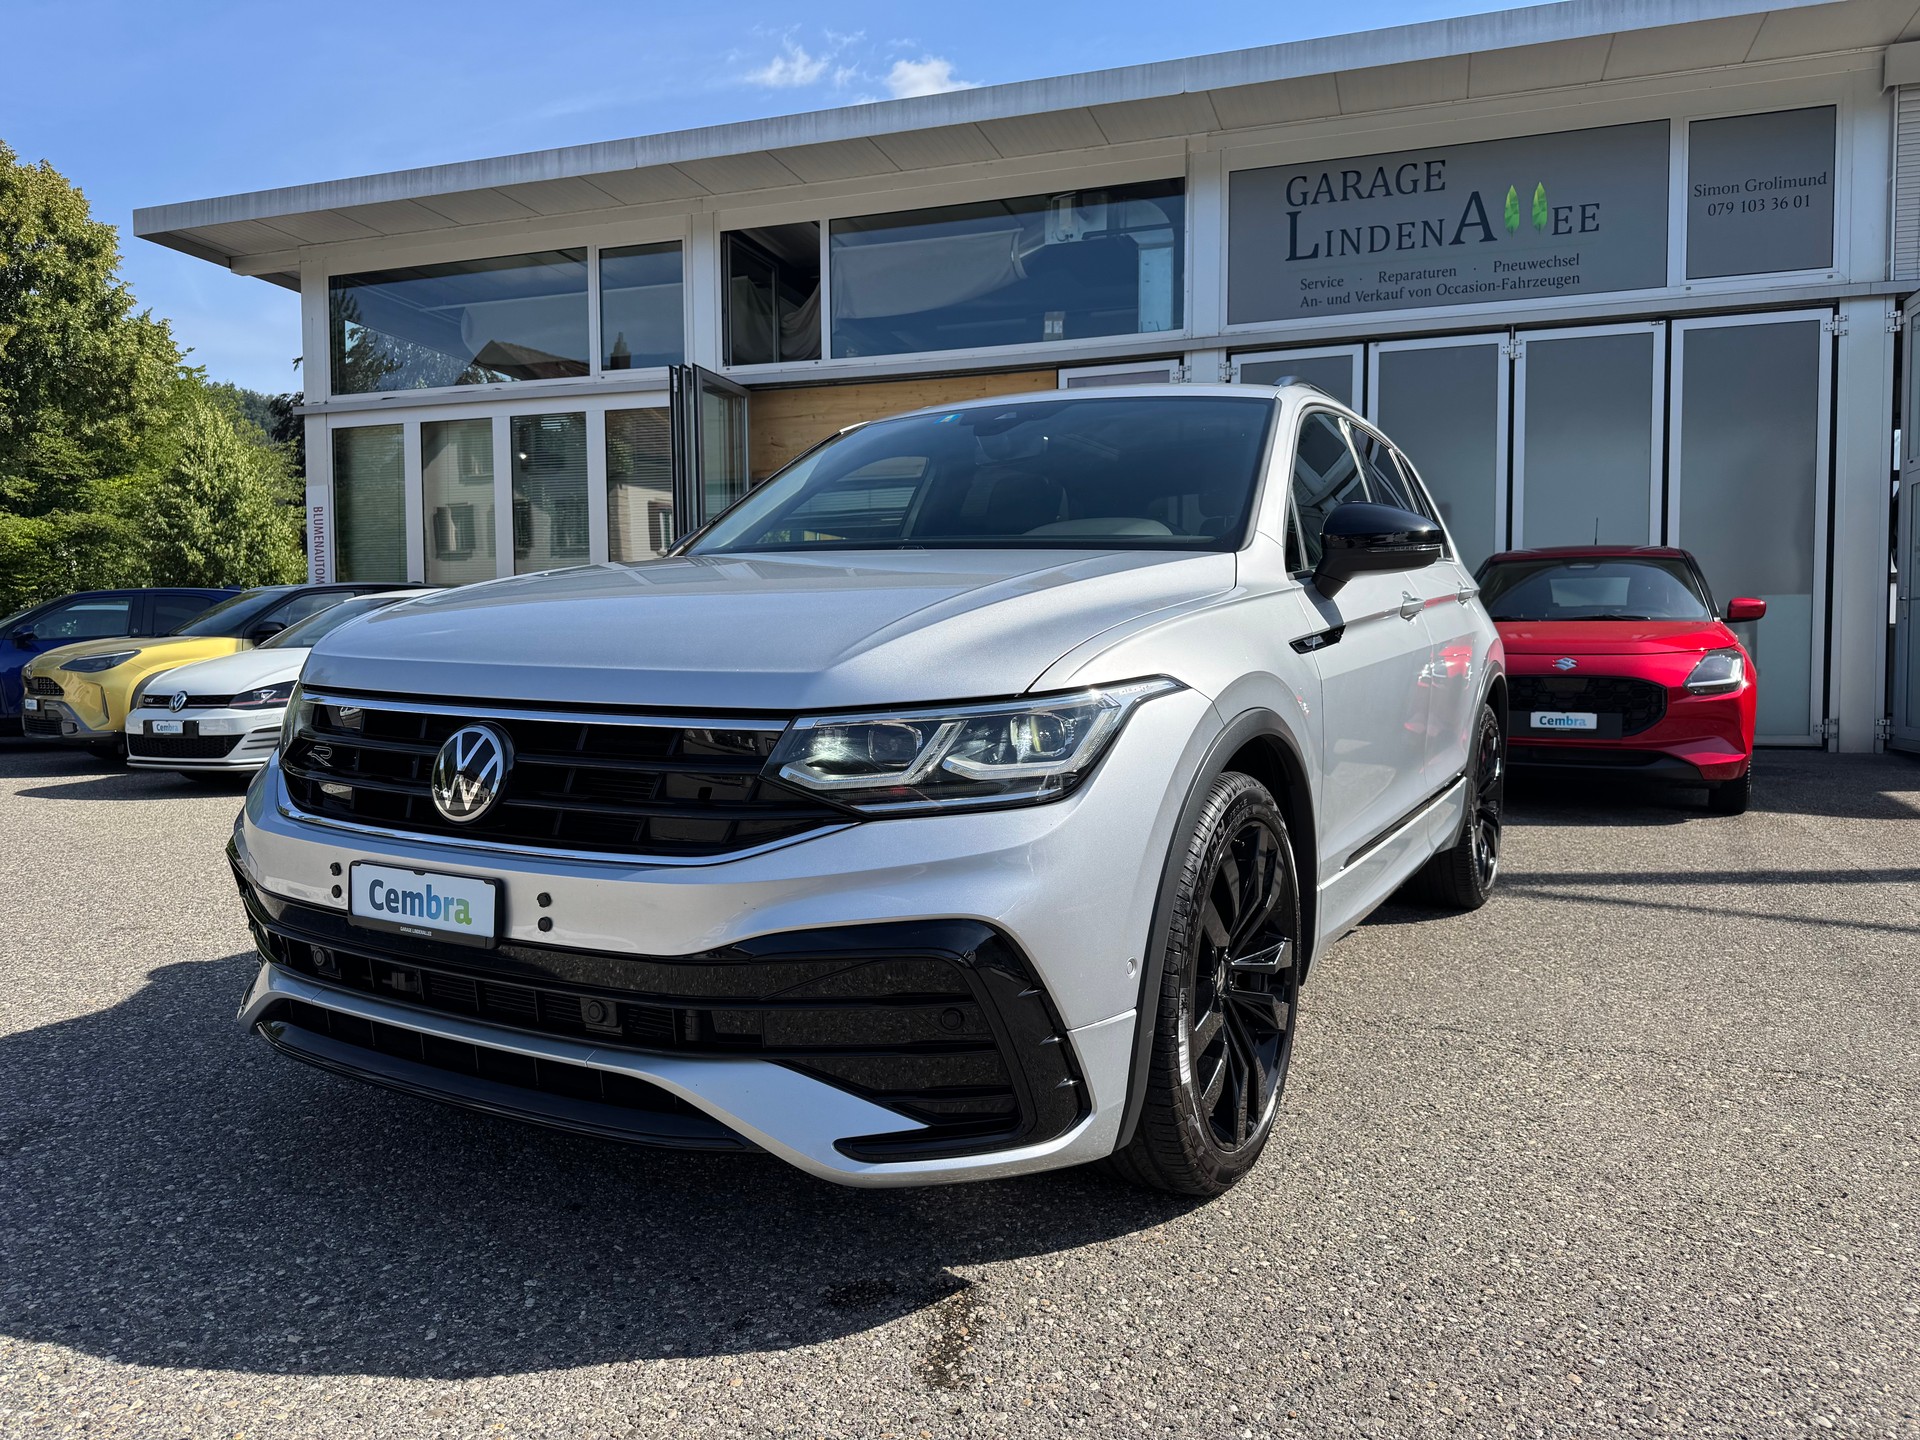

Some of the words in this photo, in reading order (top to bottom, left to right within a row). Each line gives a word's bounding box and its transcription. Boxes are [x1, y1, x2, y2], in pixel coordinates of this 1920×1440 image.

[1286, 160, 1446, 207] GARAGE
[1694, 183, 1740, 198] Simon
[1745, 171, 1827, 192] Grolimund
[1708, 201, 1734, 216] 079
[1741, 199, 1765, 213] 103
[1771, 197, 1788, 210] 36
[1793, 194, 1810, 208] 01
[1300, 276, 1344, 291] Service
[1378, 267, 1457, 285] Reparaturen
[1493, 253, 1580, 273] Pneuwechsel
[1300, 296, 1323, 308] An-
[1327, 292, 1350, 306] und
[1355, 287, 1405, 303] Verkauf
[1408, 287, 1432, 299] von
[1436, 274, 1580, 296] Occasion-Fahrzeugen
[156, 723, 179, 732] Cembra
[1539, 715, 1587, 726] Cembra
[369, 879, 472, 925] Cembra
